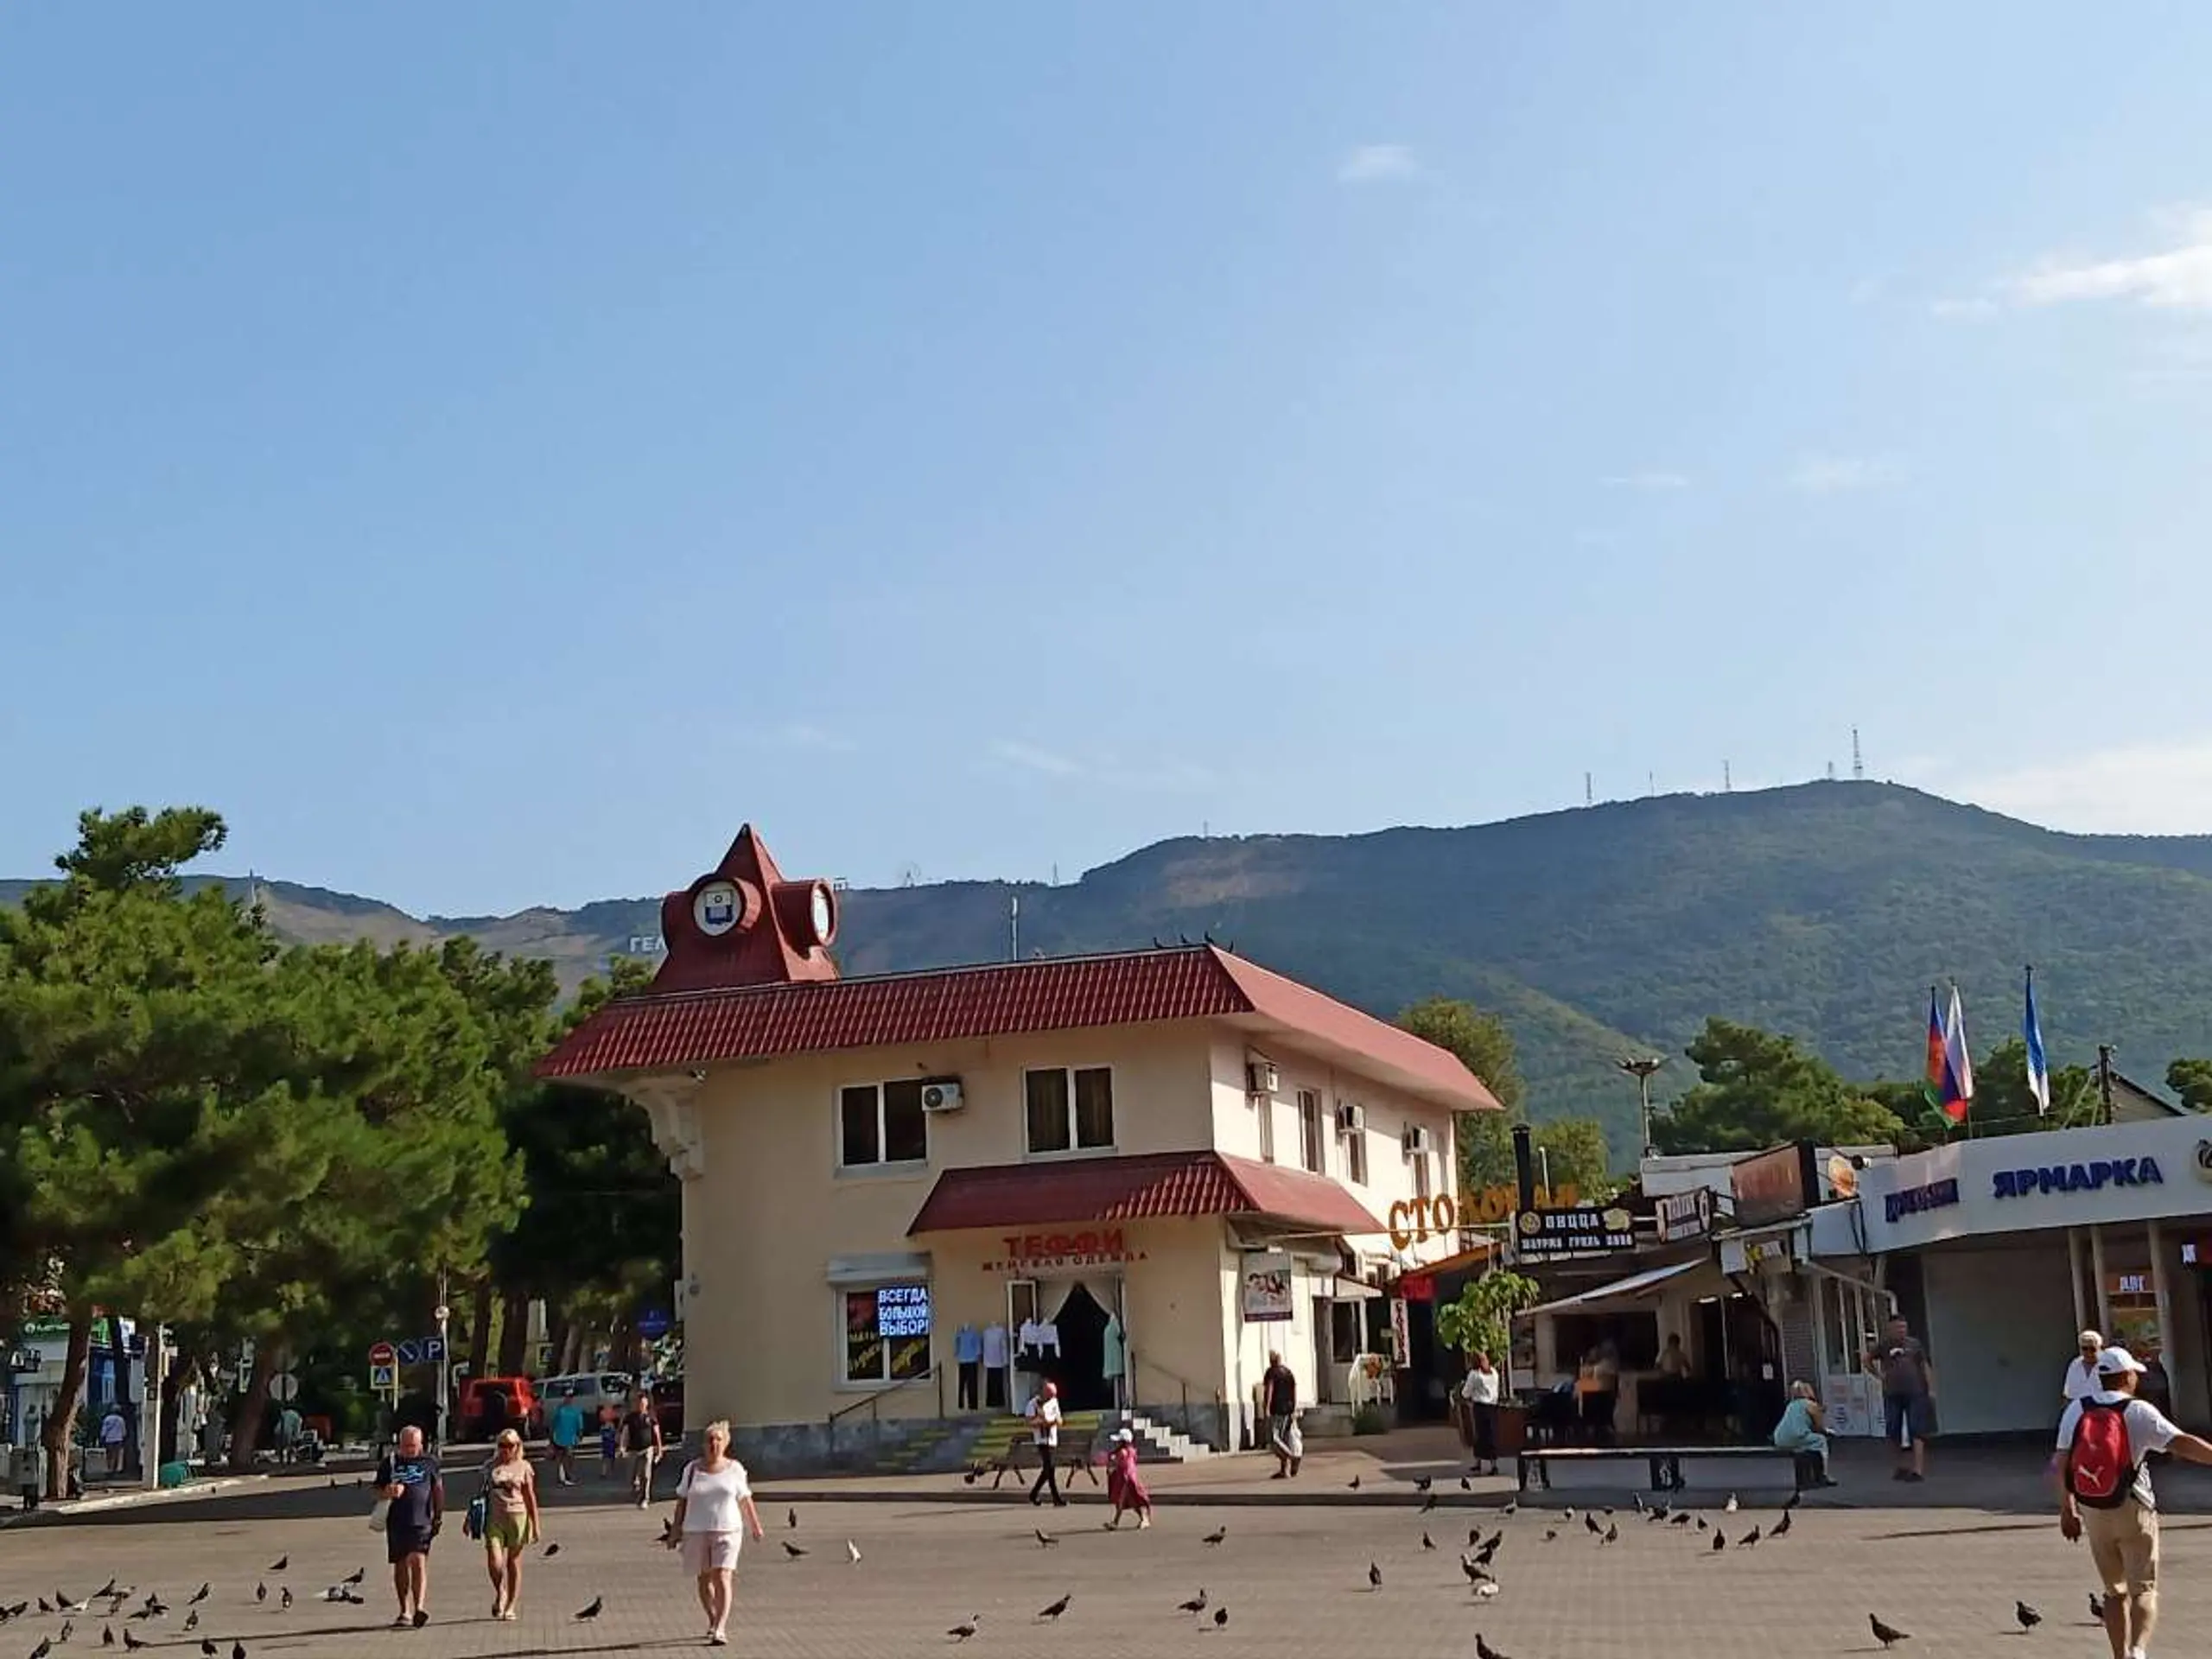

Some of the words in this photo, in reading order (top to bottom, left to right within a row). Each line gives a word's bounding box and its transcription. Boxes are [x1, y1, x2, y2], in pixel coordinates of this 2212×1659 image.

[1993, 1157, 2163, 1199] ЯРМАРКА
[1003, 1228, 1124, 1259] ТЕФФИ
[878, 1287, 928, 1303] ВСЕГДА
[879, 1303, 928, 1320] БОЛЬШОЙ
[879, 1319, 929, 1336] ВЫБОР!
[428, 1340, 441, 1358] P
